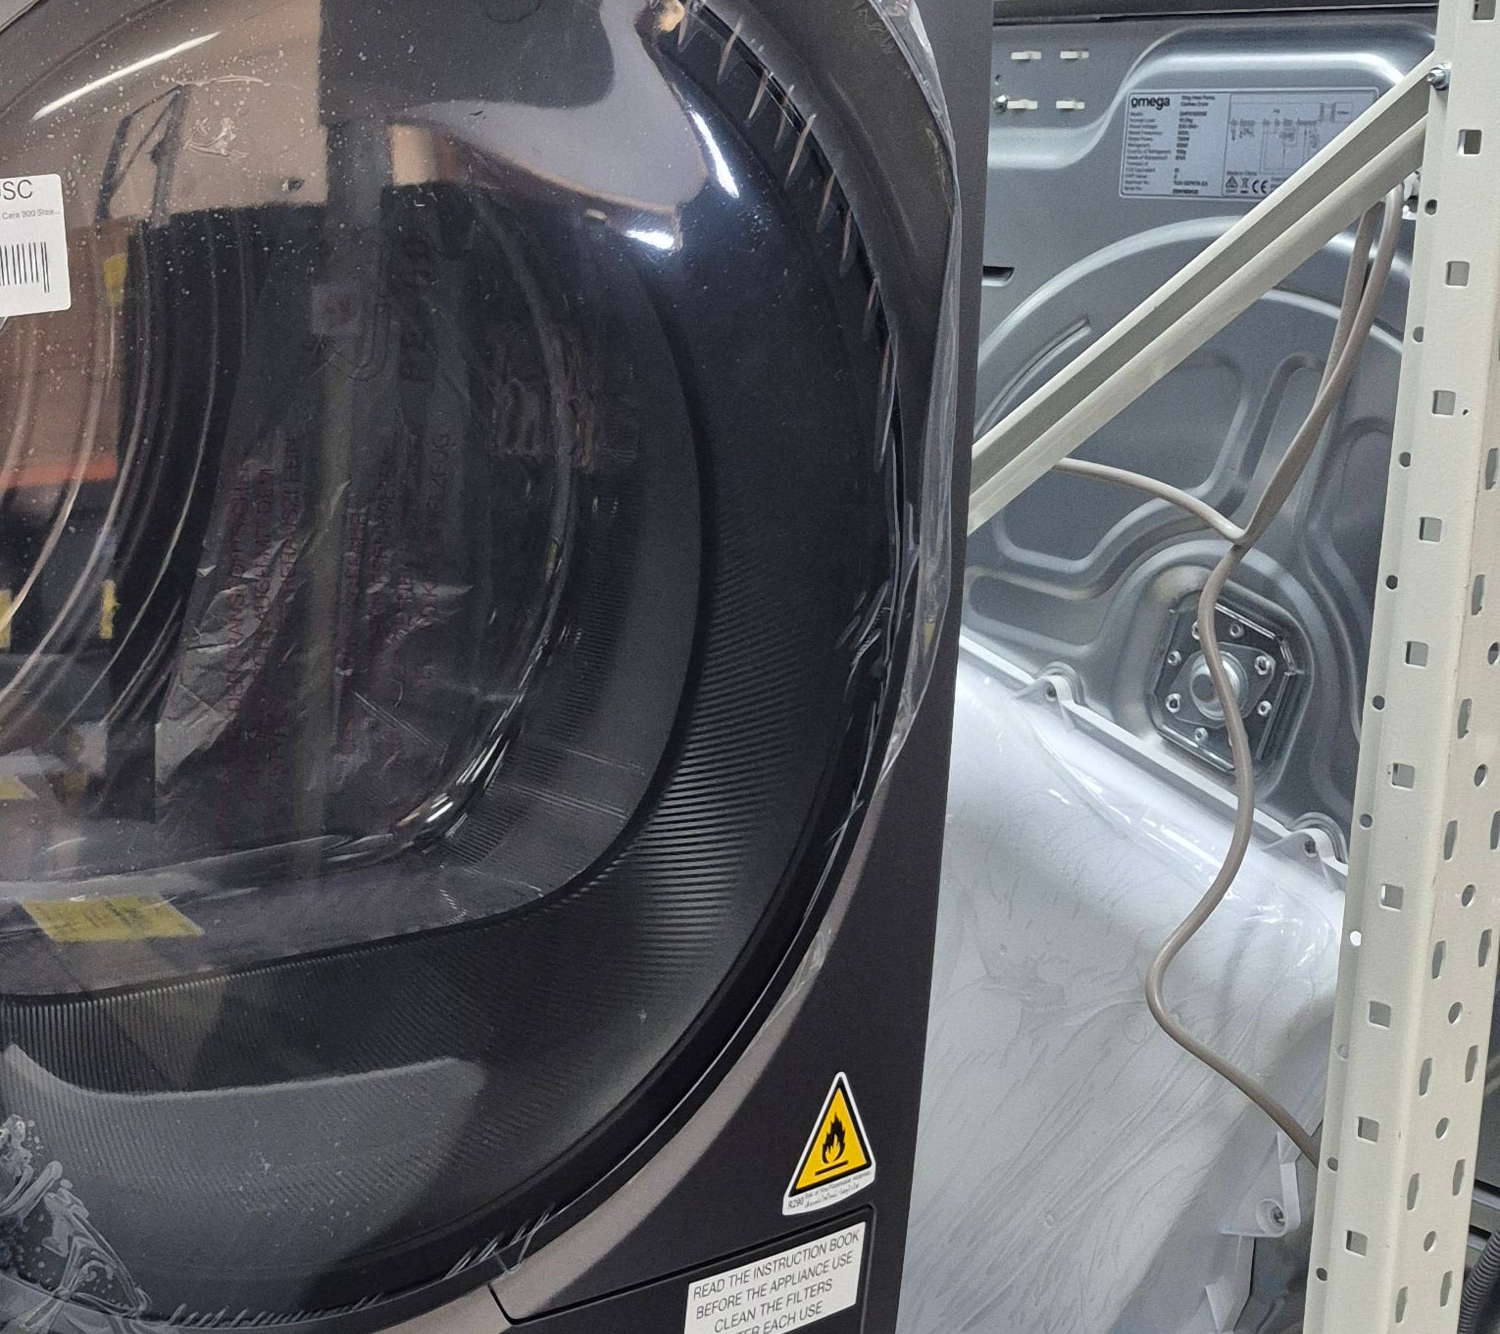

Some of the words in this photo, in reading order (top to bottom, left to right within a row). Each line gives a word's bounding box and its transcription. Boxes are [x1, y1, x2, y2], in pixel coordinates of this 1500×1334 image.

[1131, 96, 1170, 110] omega
[693, 1277, 725, 1300] READ
[727, 1269, 750, 1289] THE
[752, 1241, 827, 1280] INSTRUCTION
[828, 1228, 860, 1251] BOOK
[695, 1291, 742, 1320] BEFORE
[745, 1283, 767, 1302] THE
[769, 1260, 829, 1293] APPLIANCE
[831, 1250, 853, 1269] USE
[713, 1306, 756, 1333] CLEAN
[758, 1296, 783, 1317] THE
[785, 1277, 833, 1306] FILTERS
[762, 1311, 796, 1334] EACH
[798, 1300, 823, 1321] USE
